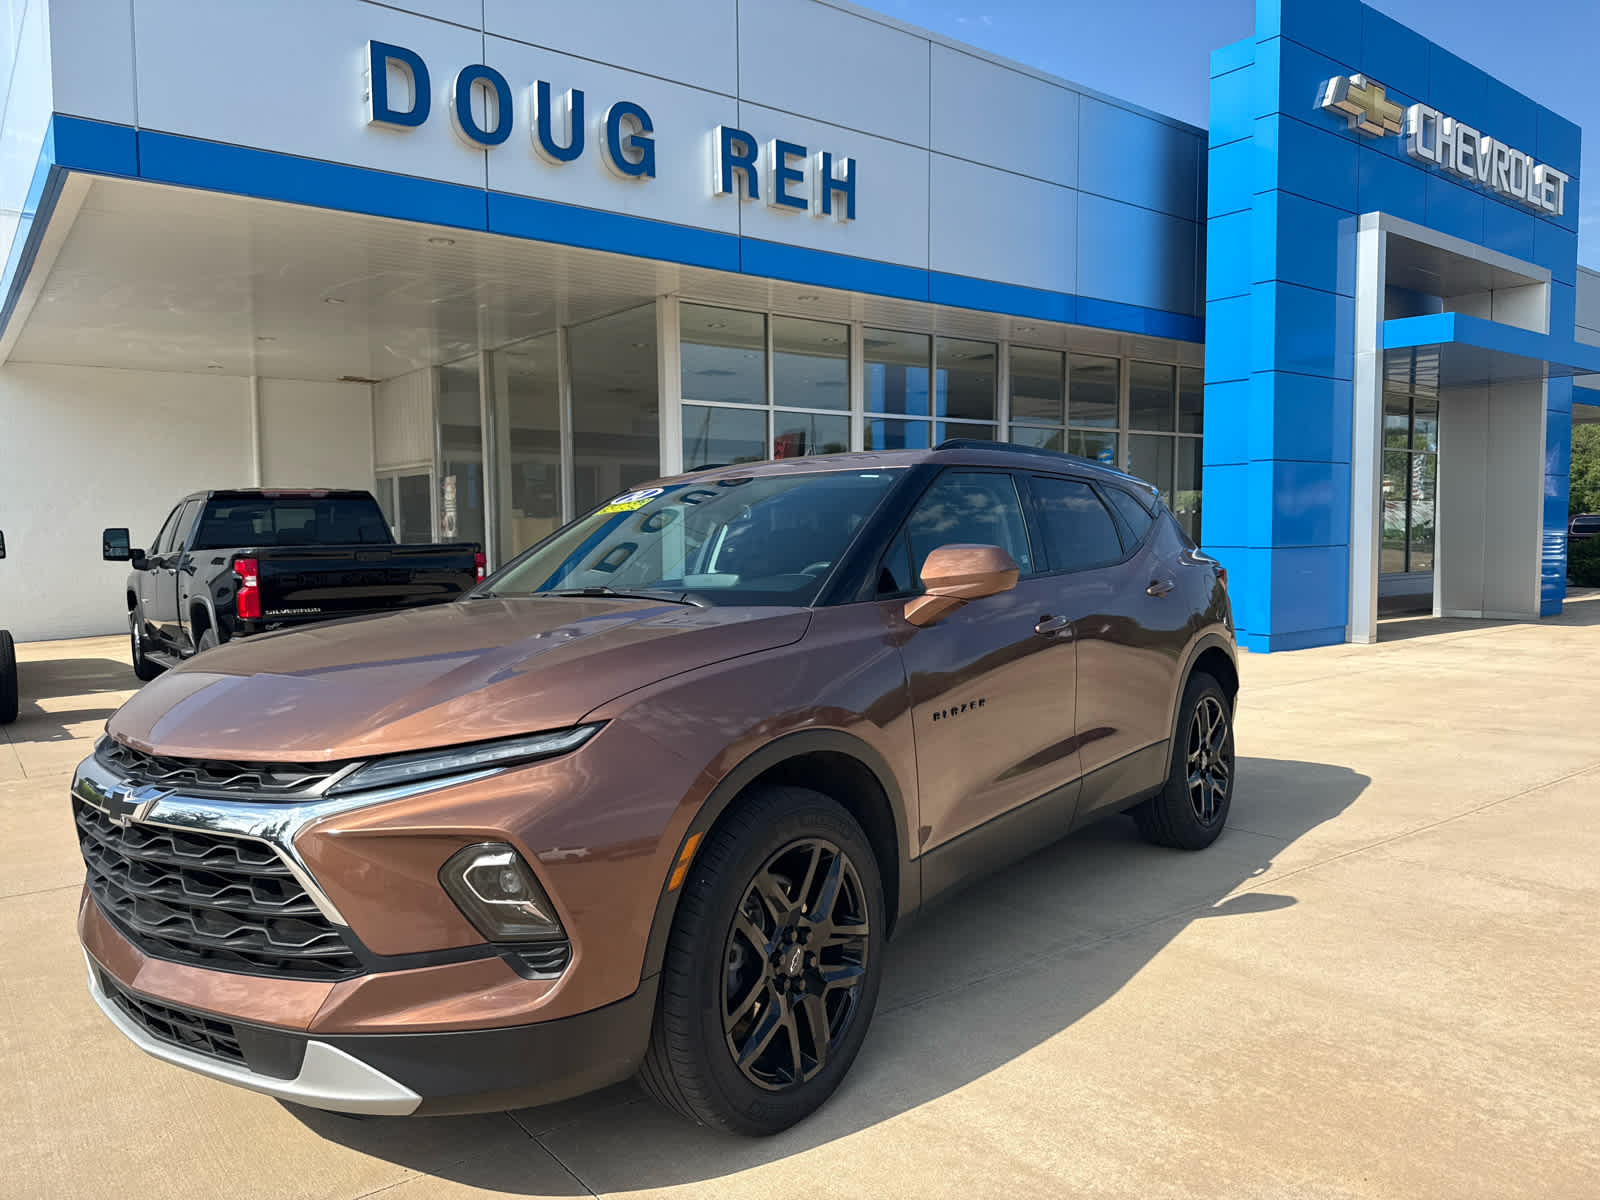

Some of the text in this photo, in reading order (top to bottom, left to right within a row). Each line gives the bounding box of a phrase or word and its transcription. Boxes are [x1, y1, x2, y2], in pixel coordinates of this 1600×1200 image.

[366, 39, 857, 221] DOUG REH
[1407, 102, 1569, 217] CHEVROLET
[932, 697, 987, 722] BLAZER
